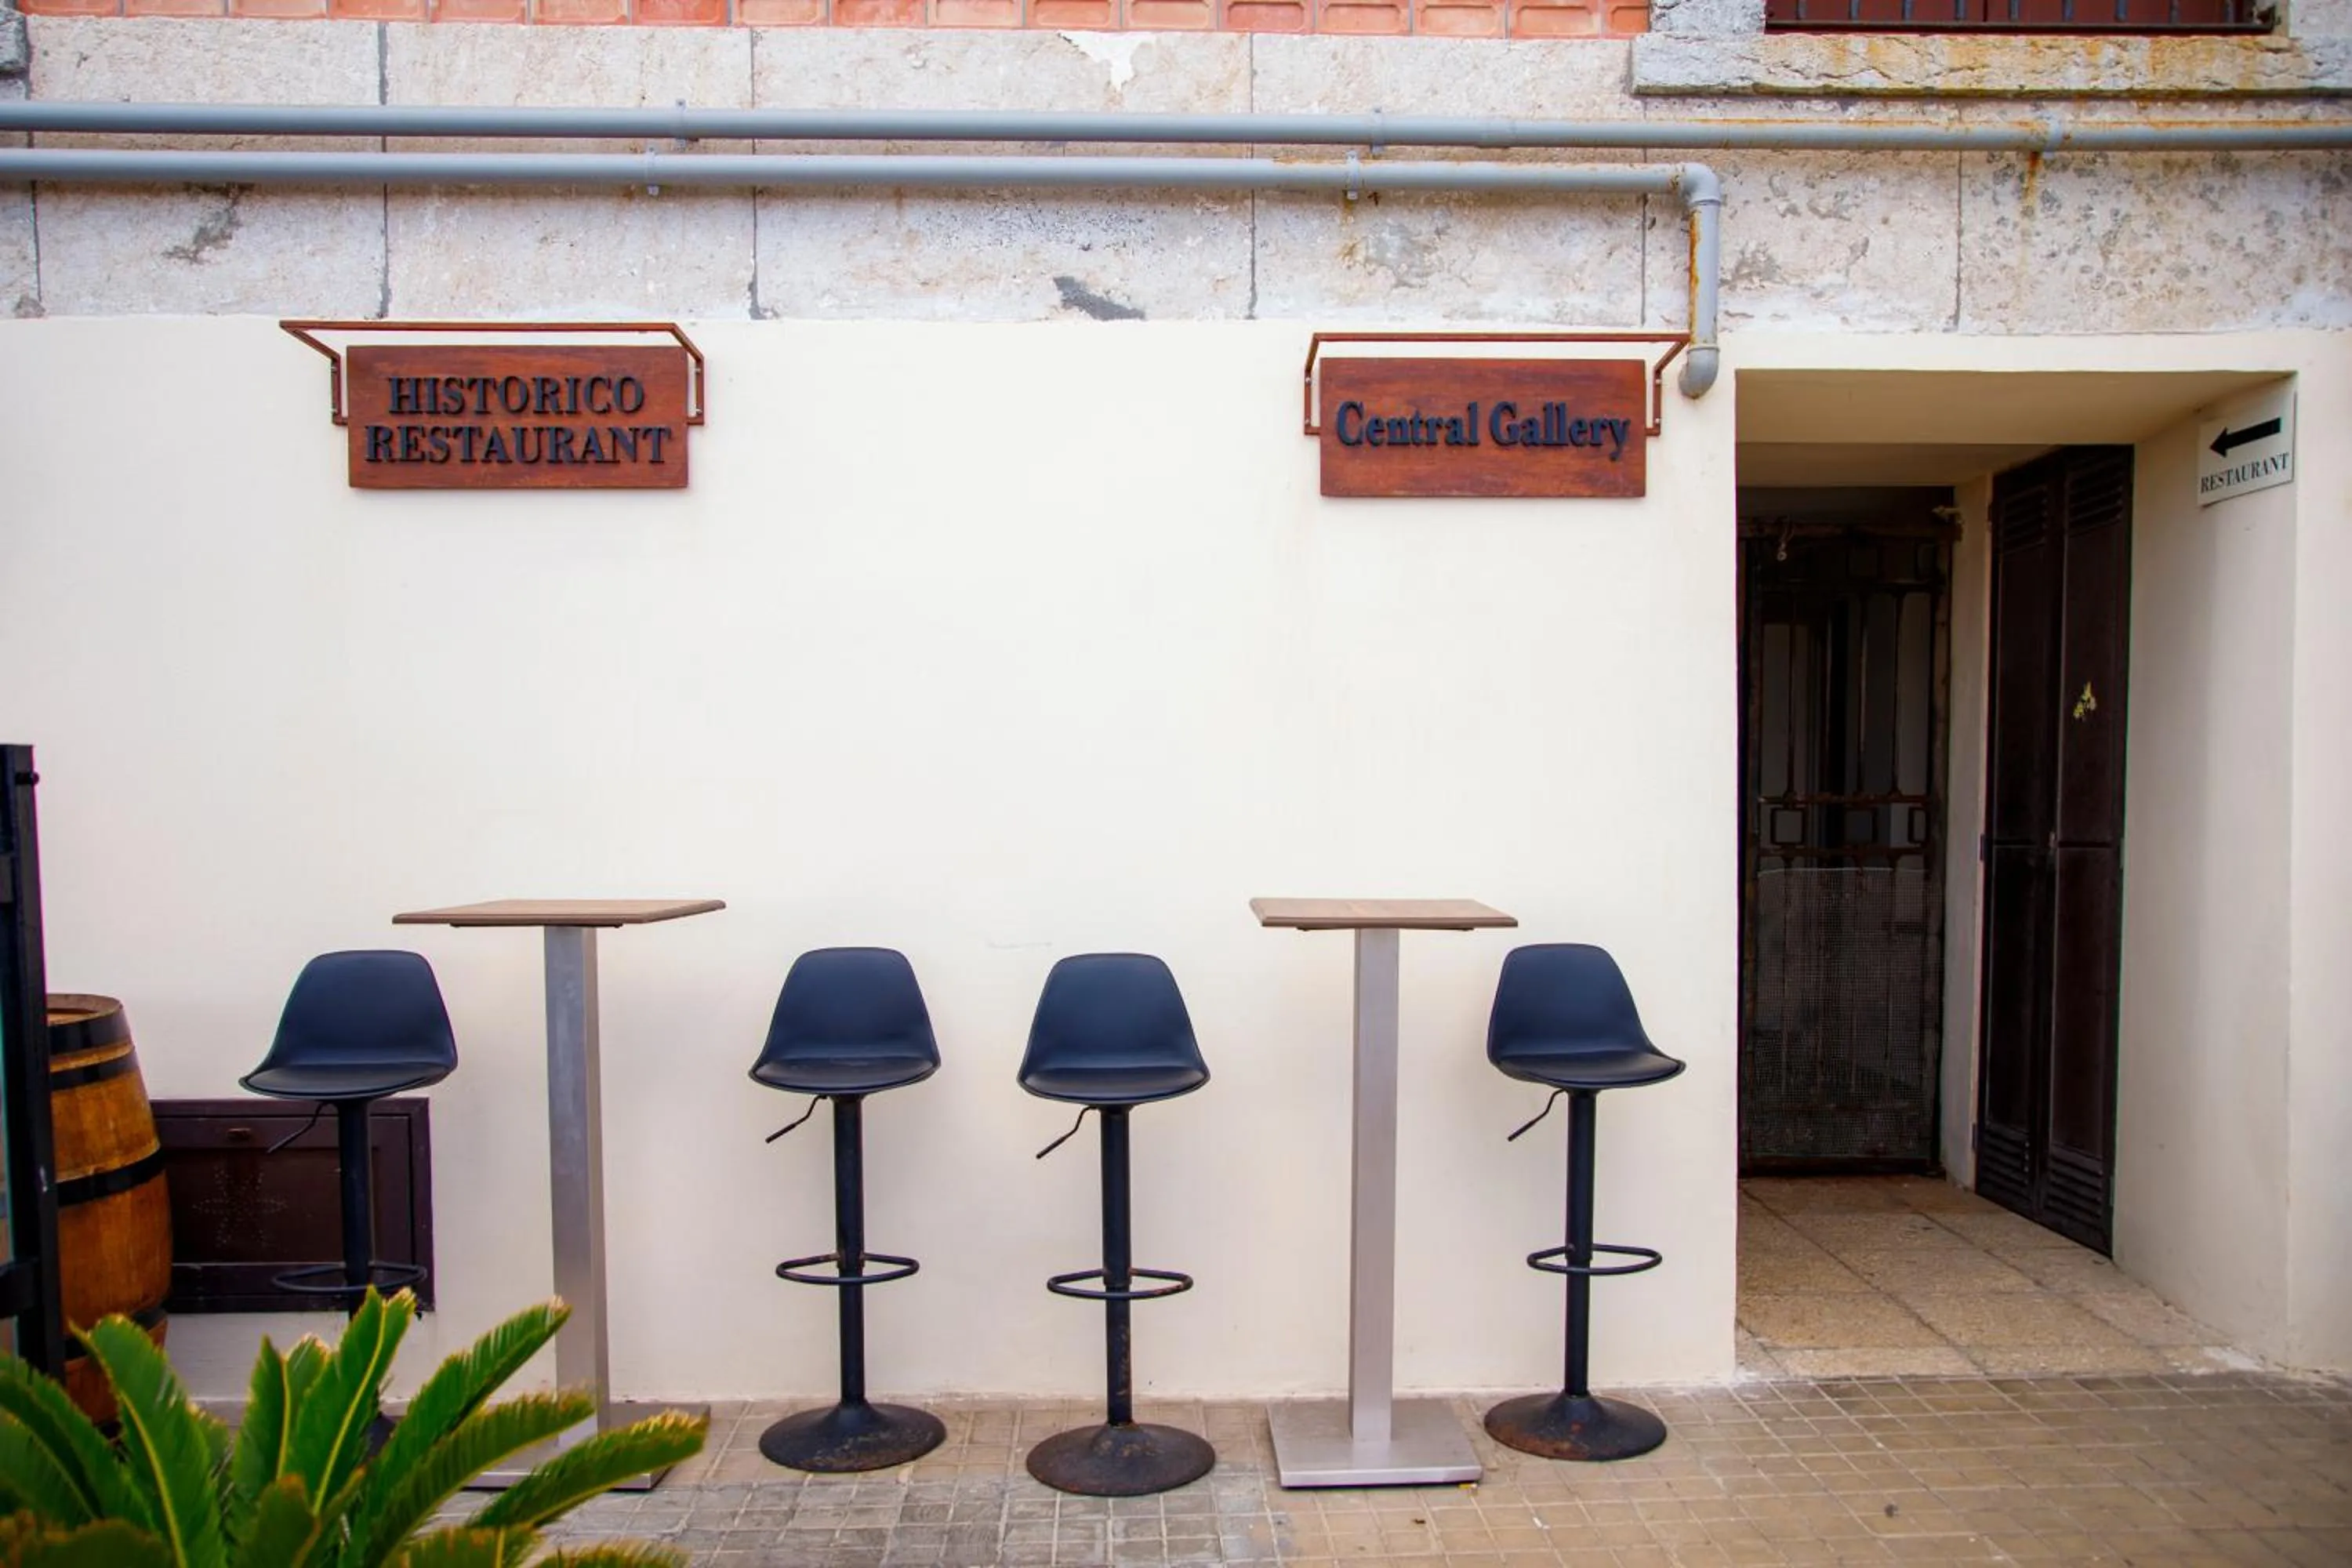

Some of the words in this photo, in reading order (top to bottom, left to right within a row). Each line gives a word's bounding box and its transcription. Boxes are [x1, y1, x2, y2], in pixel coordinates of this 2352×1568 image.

[388, 376, 645, 416] HISTORICO
[365, 425, 672, 464] RESTAURANT
[1336, 401, 1479, 447] Central
[1490, 401, 1631, 461] Gallery
[2201, 452, 2289, 494] RESTAURANT
